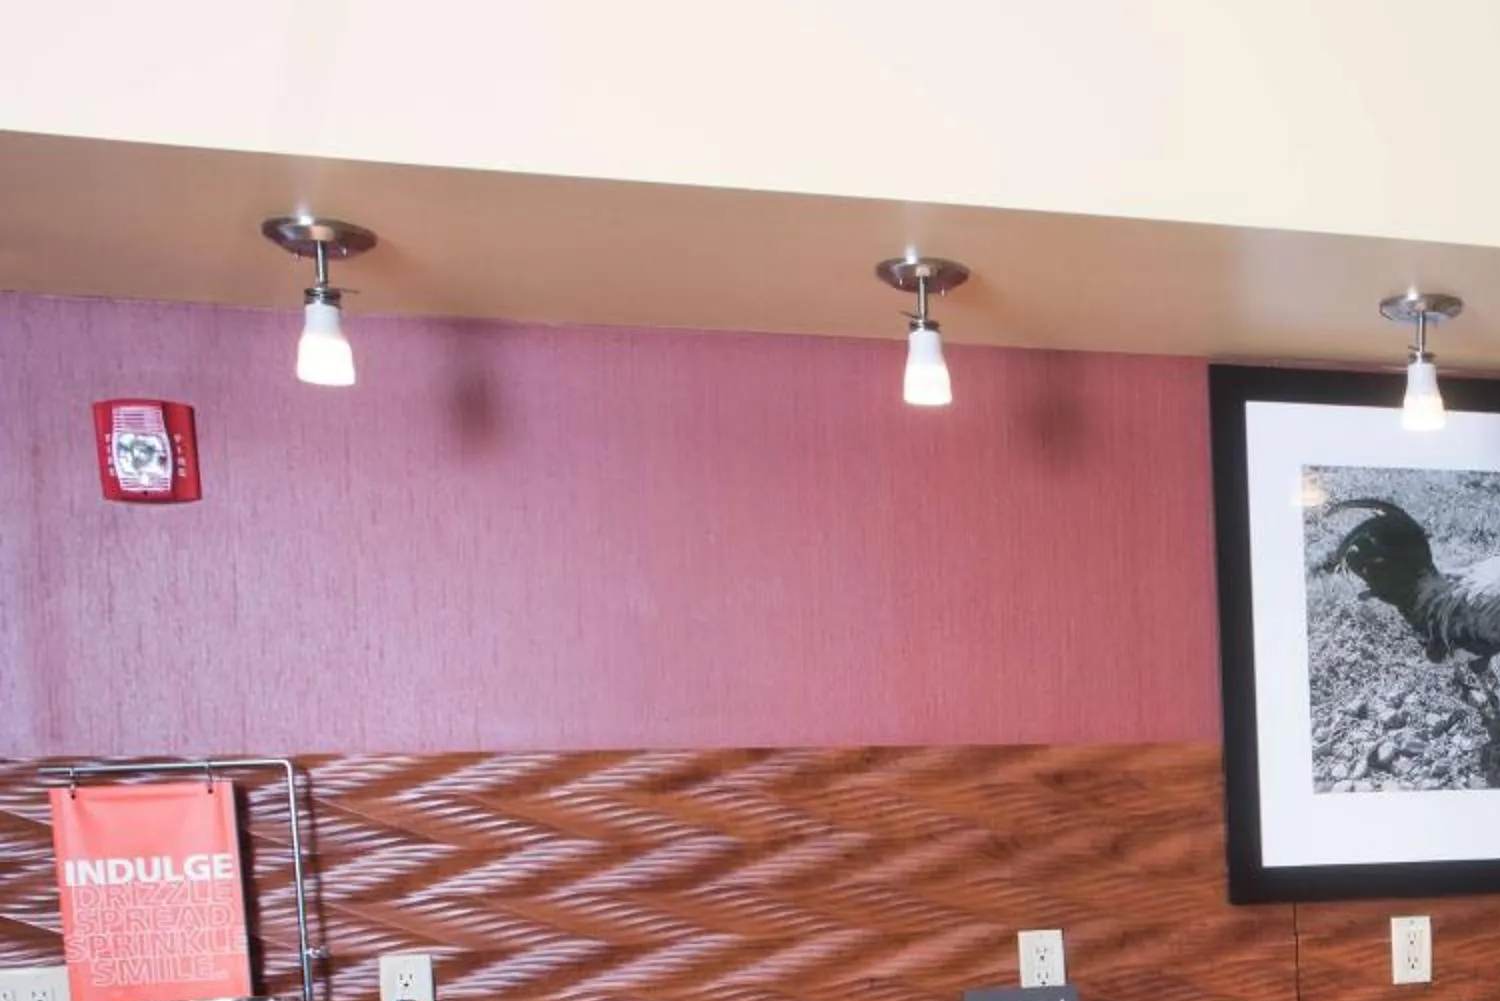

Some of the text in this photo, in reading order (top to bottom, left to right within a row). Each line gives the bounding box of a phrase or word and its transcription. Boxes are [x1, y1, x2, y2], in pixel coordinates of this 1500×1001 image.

[64, 853, 234, 887] INDULGE
[75, 880, 235, 909] DRIZZLE
[75, 904, 236, 936] SPREAD
[65, 926, 247, 962] SPRINKLE
